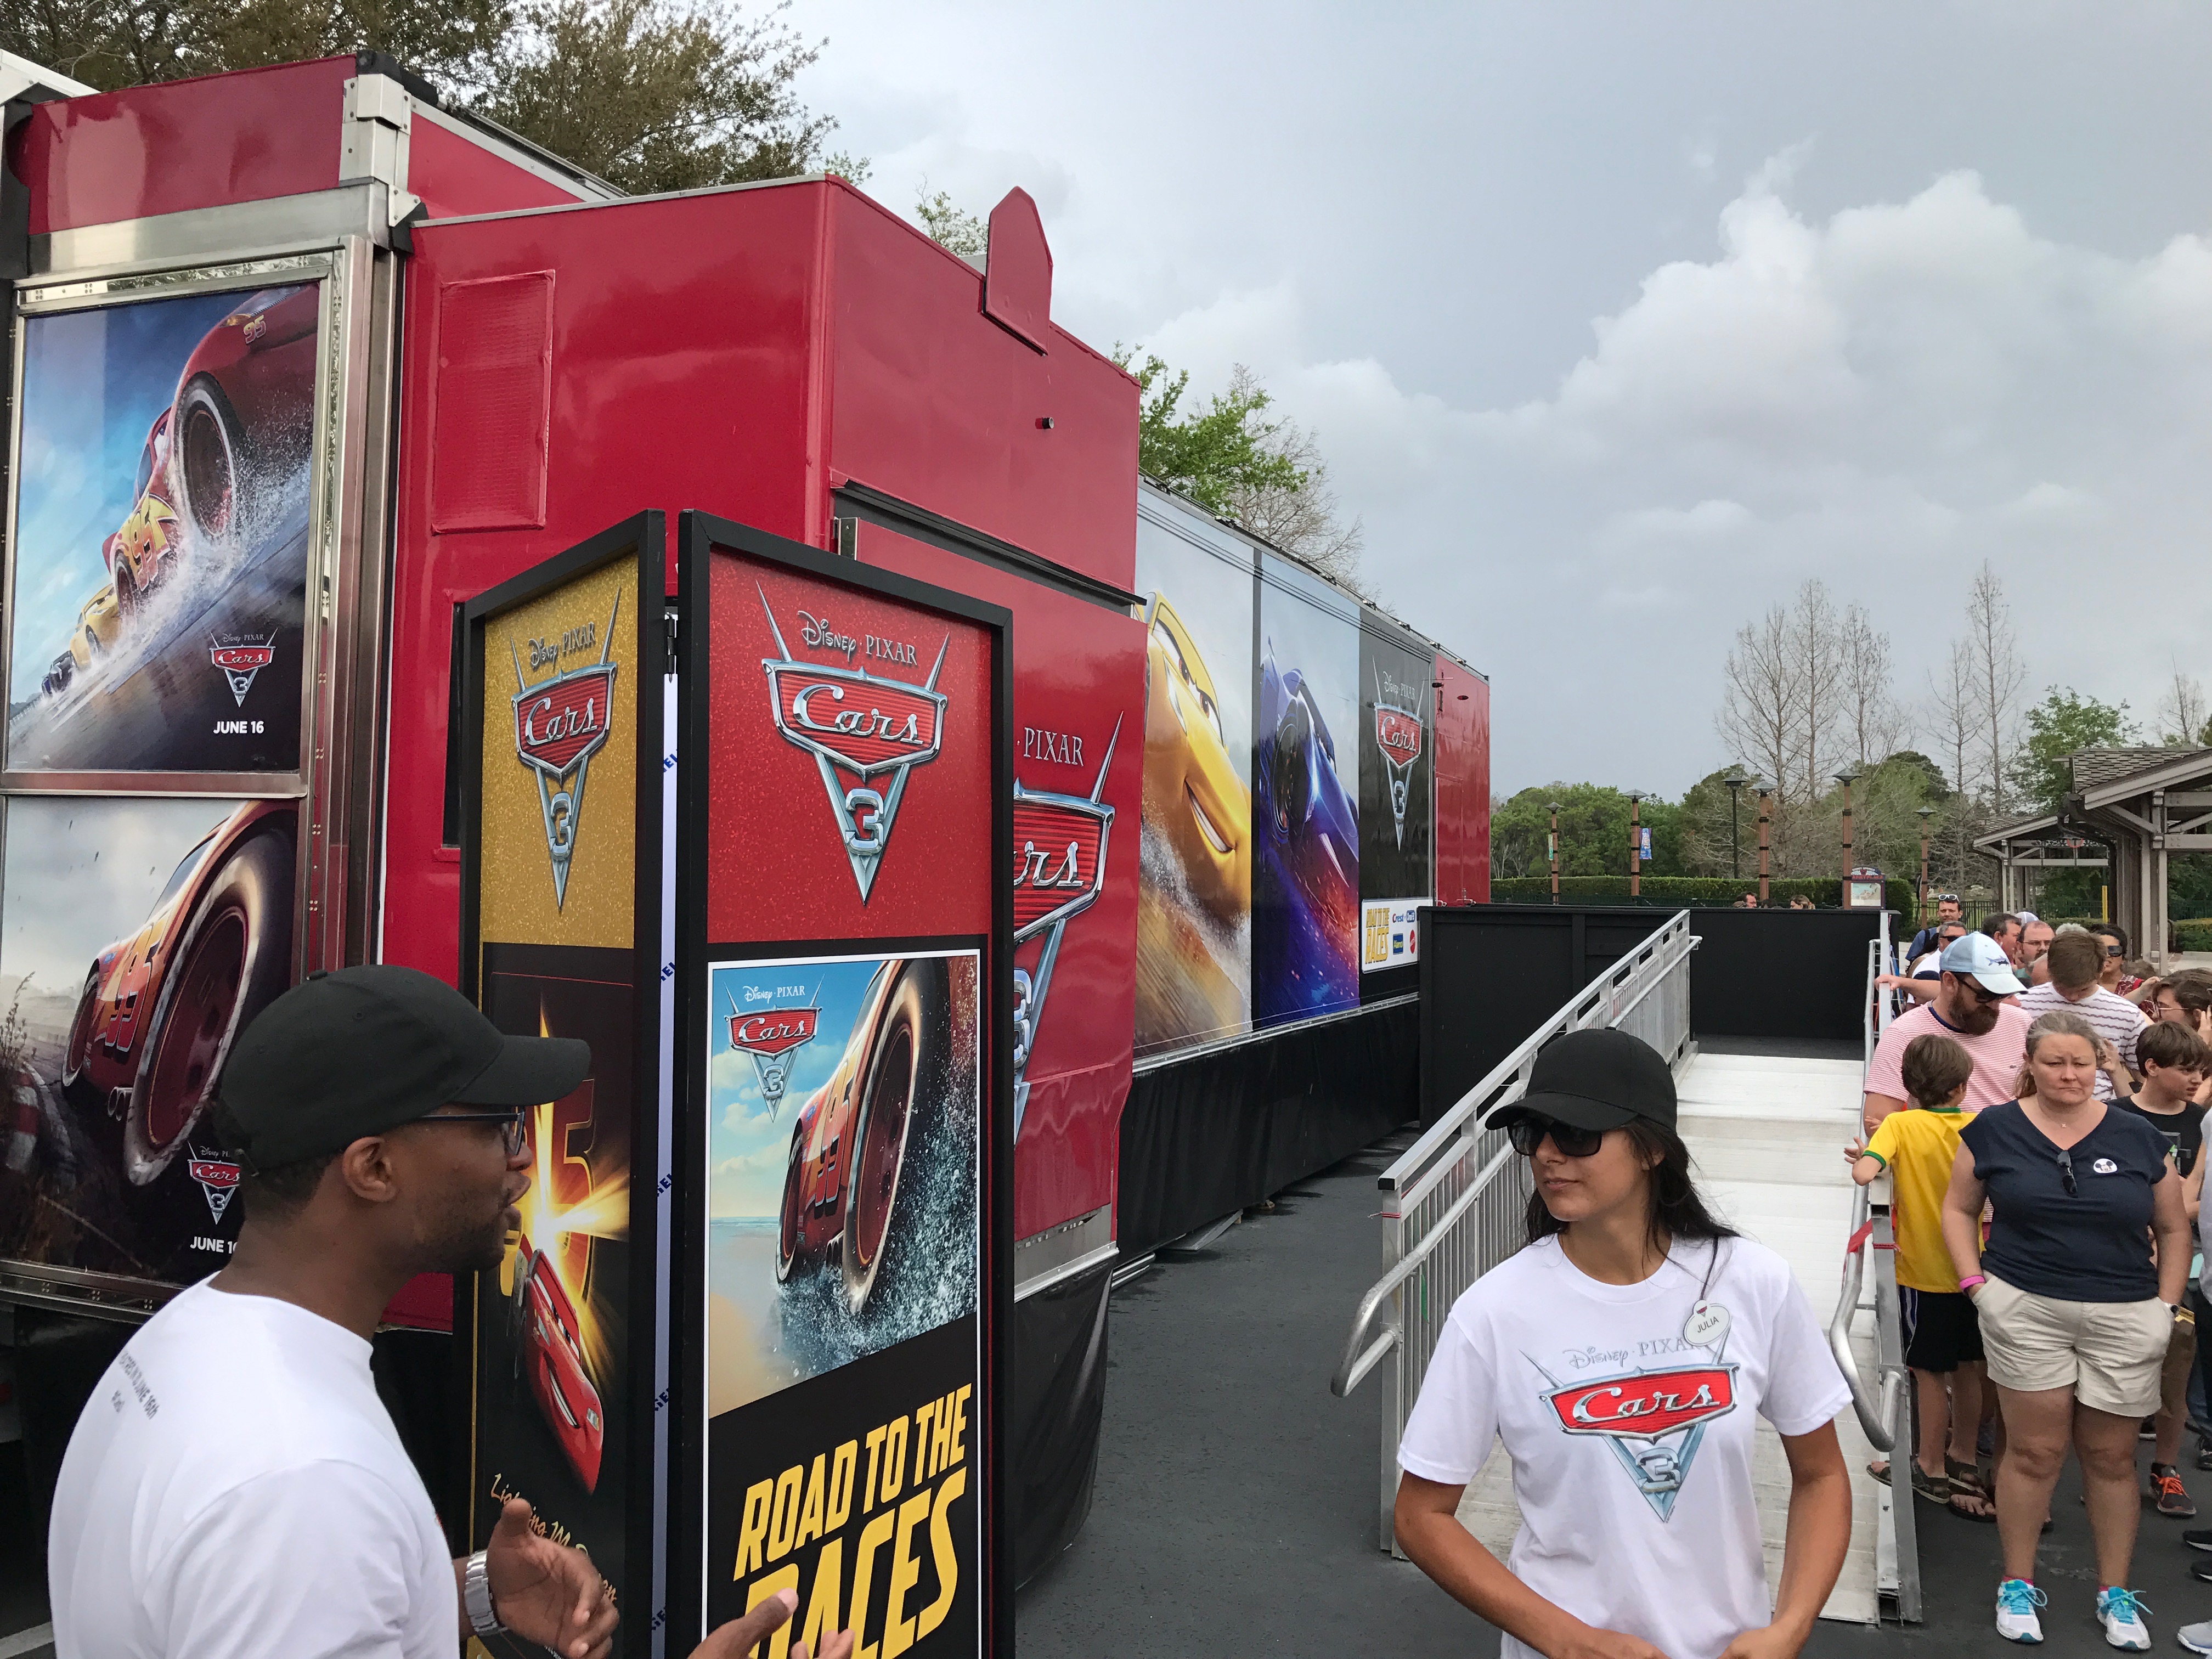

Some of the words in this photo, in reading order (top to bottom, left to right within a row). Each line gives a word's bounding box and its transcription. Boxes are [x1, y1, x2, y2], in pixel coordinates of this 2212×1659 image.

[243, 315, 267, 345] 95
[218, 650, 266, 664] Cars
[562, 622, 596, 657] PIXAR
[865, 634, 918, 666] PIXAR
[234, 676, 247, 696] 3
[1400, 682, 1415, 701] PIXAR
[213, 720, 247, 734] JUNE
[250, 720, 264, 734] 16
[524, 696, 597, 746] Cars
[793, 683, 924, 746] Cars
[1023, 726, 1084, 767] PIXAR
[1381, 715, 1416, 752] Cars
[1393, 780, 1406, 823] 3
[549, 792, 573, 860] 3
[845, 787, 884, 856] 3
[1014, 840, 1084, 888] rs
[1392, 913, 1404, 923] Crest
[777, 985, 805, 998] PIXAR
[738, 1017, 807, 1043] Cars
[764, 1064, 784, 1099] 3
[196, 1165, 240, 1182] Cars
[211, 1193, 225, 1213] 3
[190, 1236, 224, 1253] JUNE
[1697, 1316, 1719, 1334] JULIA
[1572, 1384, 1721, 1423] Cars
[733, 1438, 859, 1582] ROAD
[863, 1415, 909, 1515] TO
[913, 1383, 972, 1487] THE
[1635, 1447, 1682, 1493] 3
[742, 1466, 967, 1659] RACES
